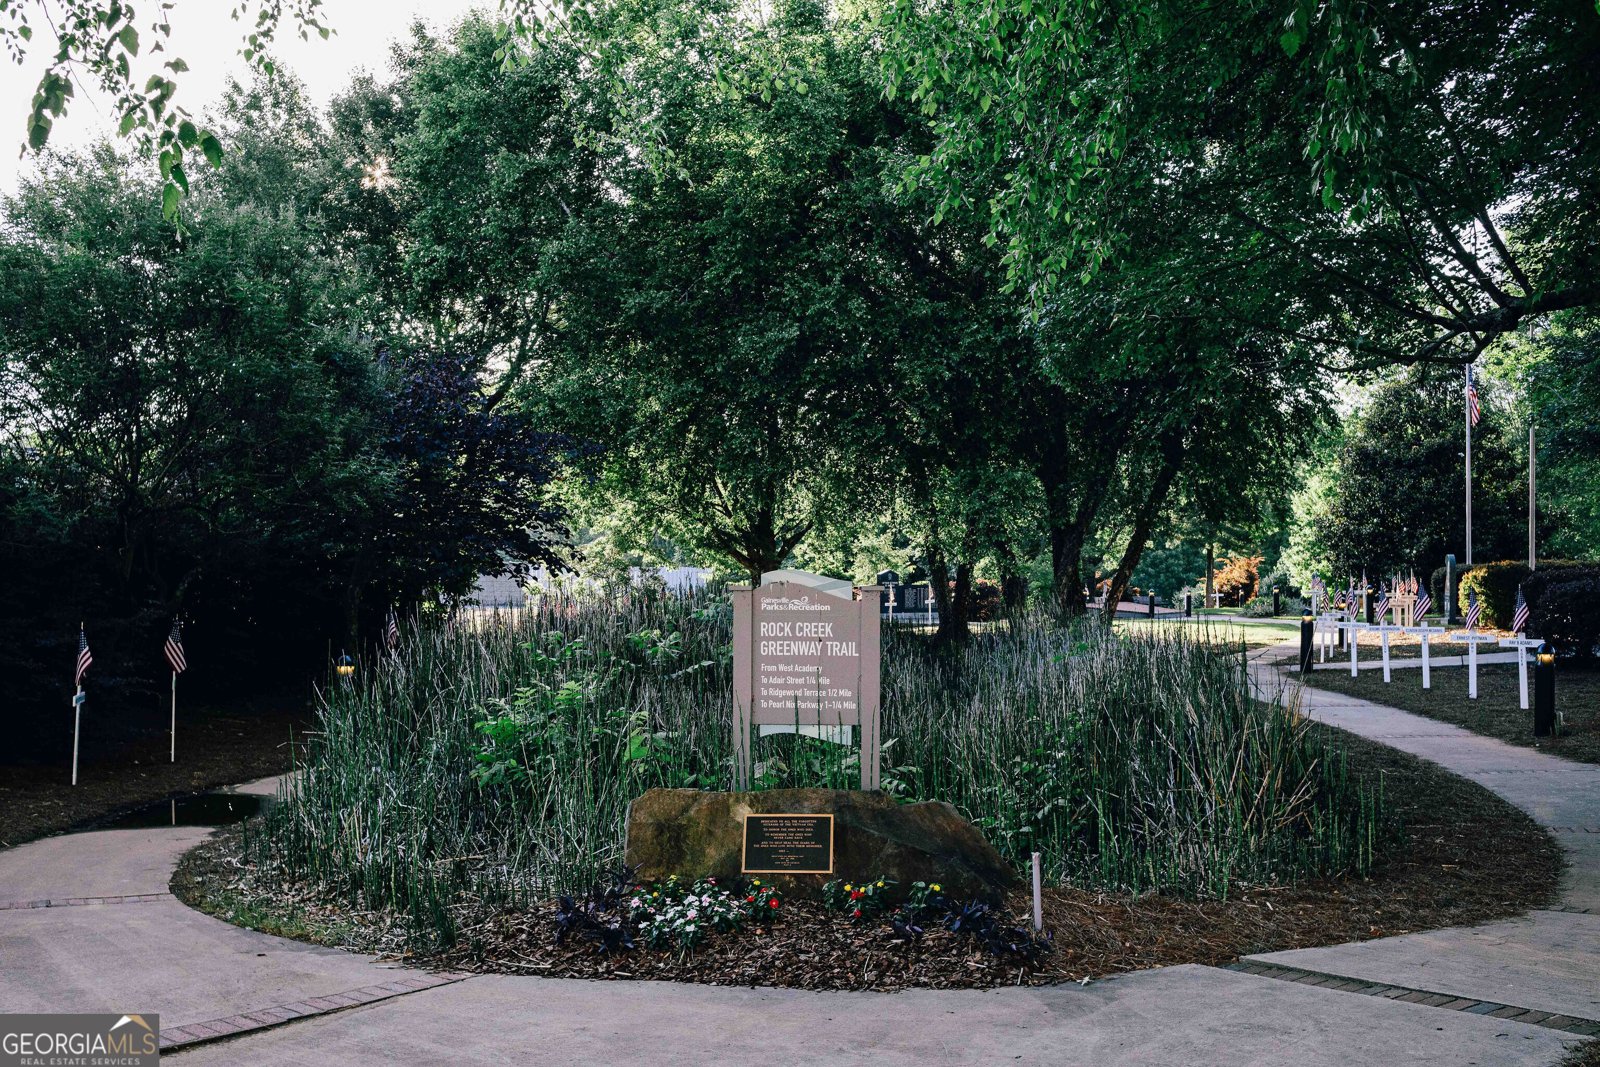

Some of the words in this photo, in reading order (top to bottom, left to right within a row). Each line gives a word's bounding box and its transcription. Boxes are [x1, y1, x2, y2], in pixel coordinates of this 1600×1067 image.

[760, 622, 792, 637] ROCK
[795, 622, 833, 637] CREEK
[760, 640, 823, 656] GREENWAY
[826, 641, 860, 656] TRAIL
[761, 664, 777, 672] From
[778, 664, 794, 672] West
[794, 664, 823, 674] Academy
[760, 675, 768, 684] To
[768, 675, 785, 684] Adair
[786, 676, 805, 685] Street
[806, 676, 816, 685] 1/4
[760, 687, 768, 696] To
[768, 687, 802, 698] Ridgewood
[803, 689, 827, 697] Terrace
[828, 689, 838, 697] 1/2
[838, 689, 852, 697] Mile
[760, 699, 768, 708] To
[768, 699, 785, 708] Pearl
[785, 700, 796, 709] Nix
[796, 700, 823, 710] Parkway
[843, 701, 857, 710] Mile
